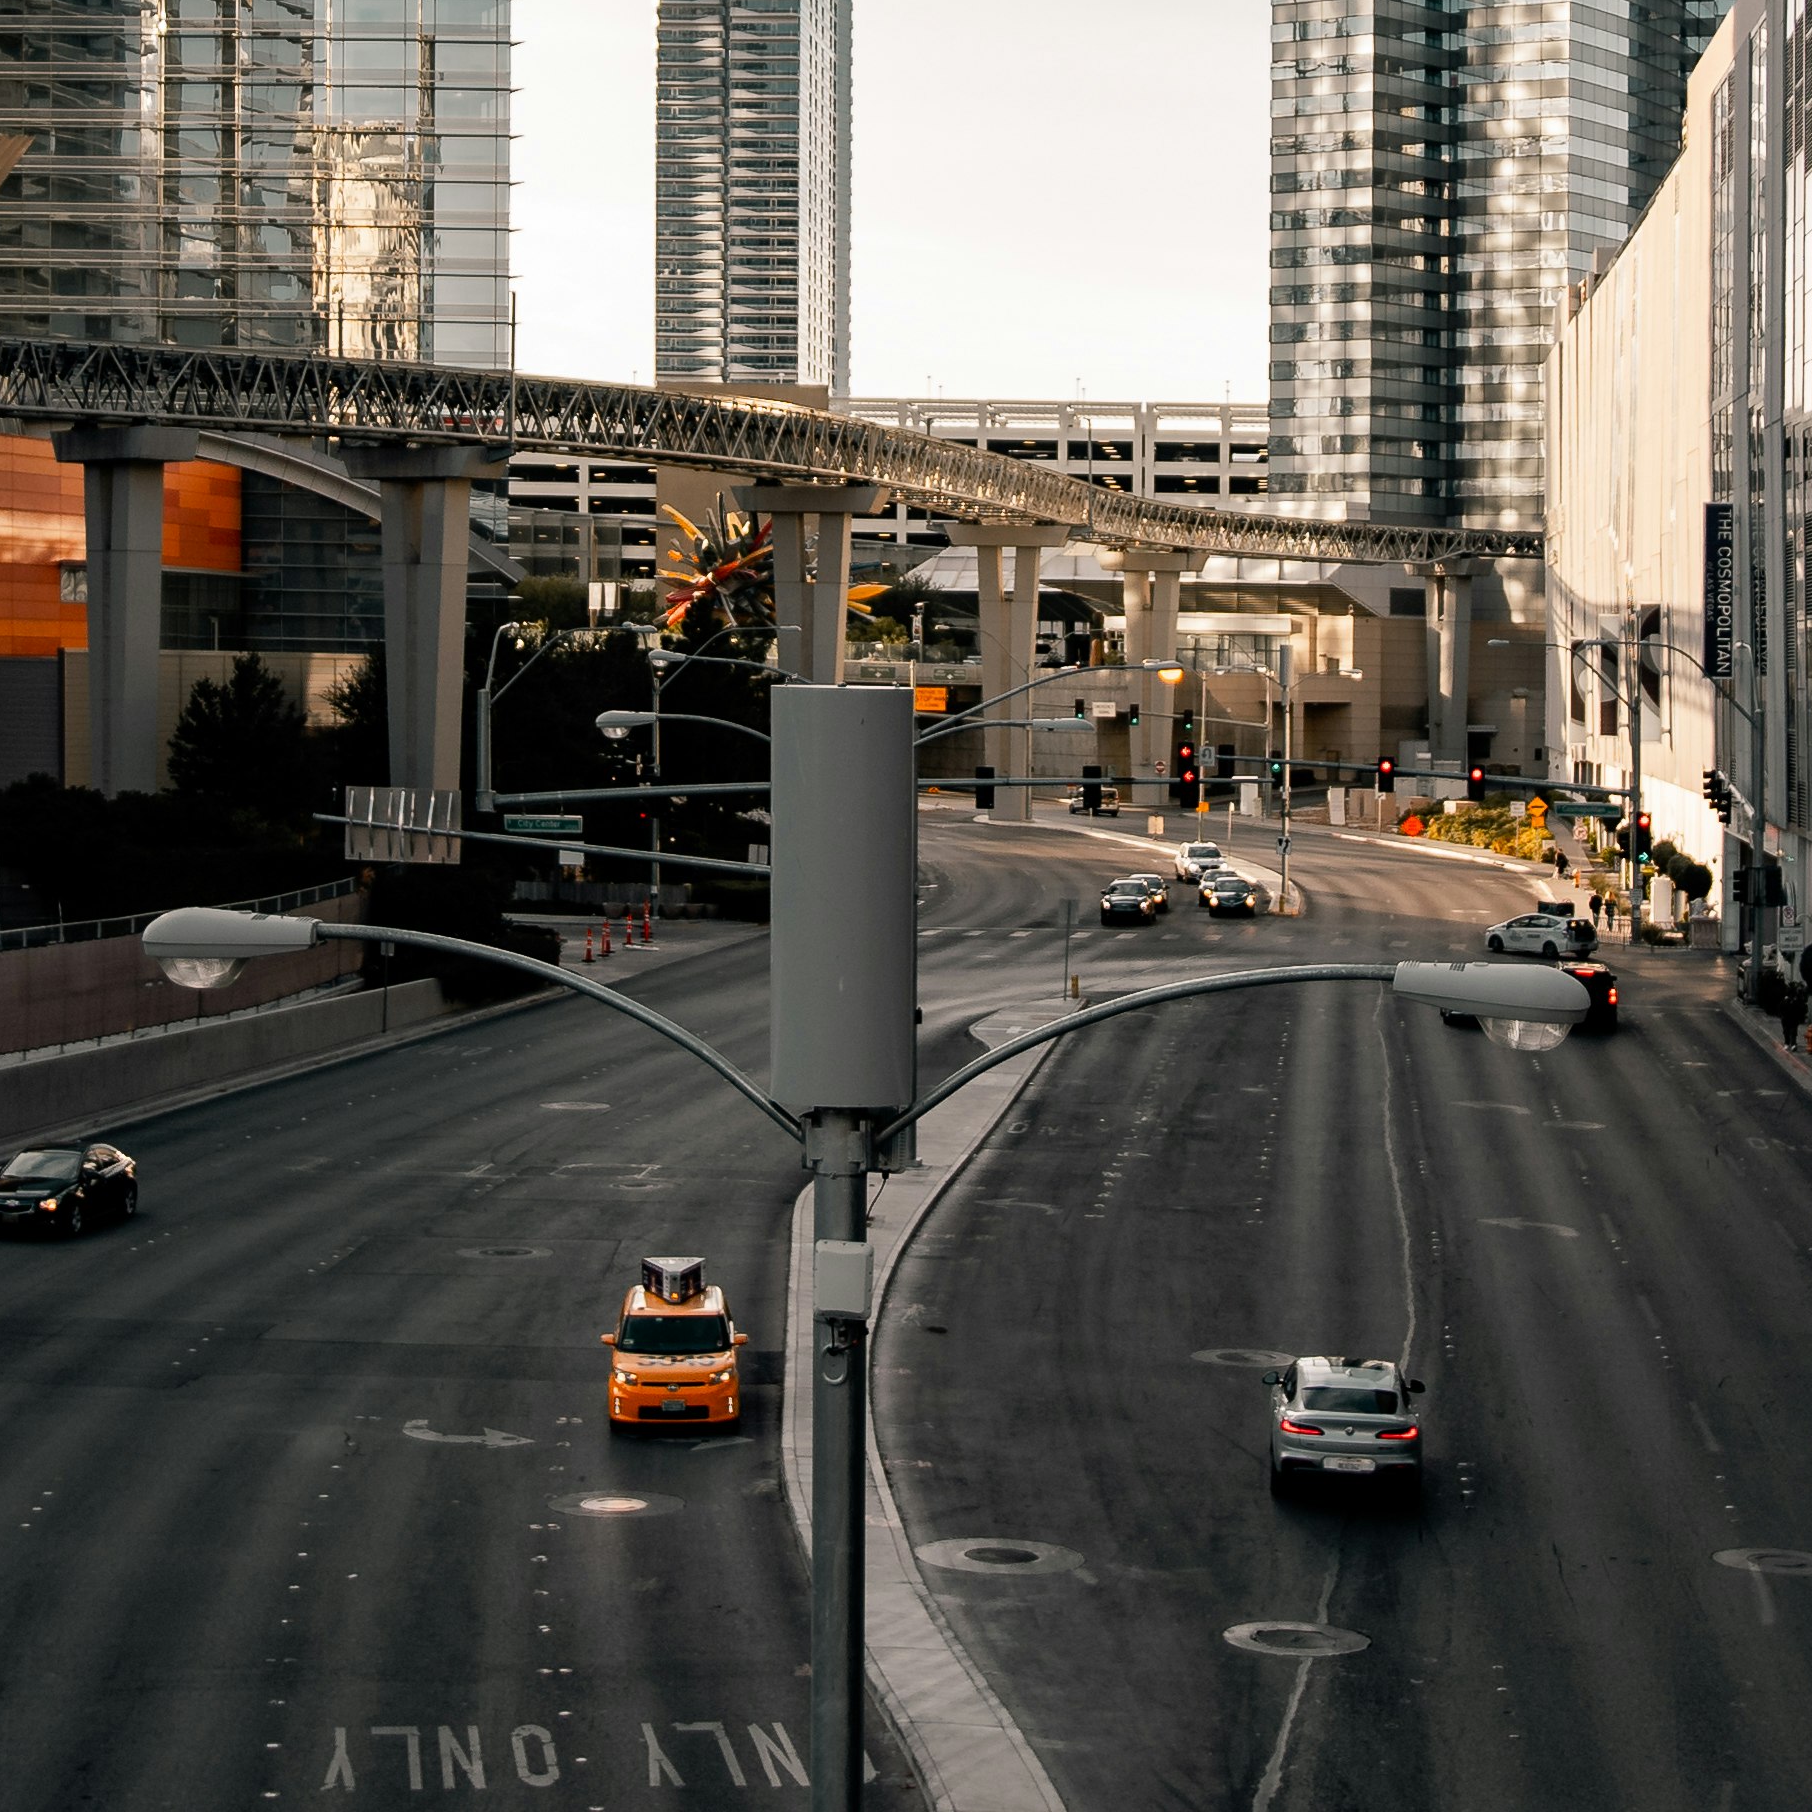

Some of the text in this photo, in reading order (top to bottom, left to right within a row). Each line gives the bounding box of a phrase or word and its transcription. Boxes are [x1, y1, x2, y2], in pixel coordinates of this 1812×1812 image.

[1706, 573, 1714, 590] LAS
[1716, 509, 1732, 673] THE COSMOPOLITAN
[1706, 592, 1714, 622] VEGAS
[518, 820, 533, 828] City
[320, 1724, 560, 1791] ONLY
